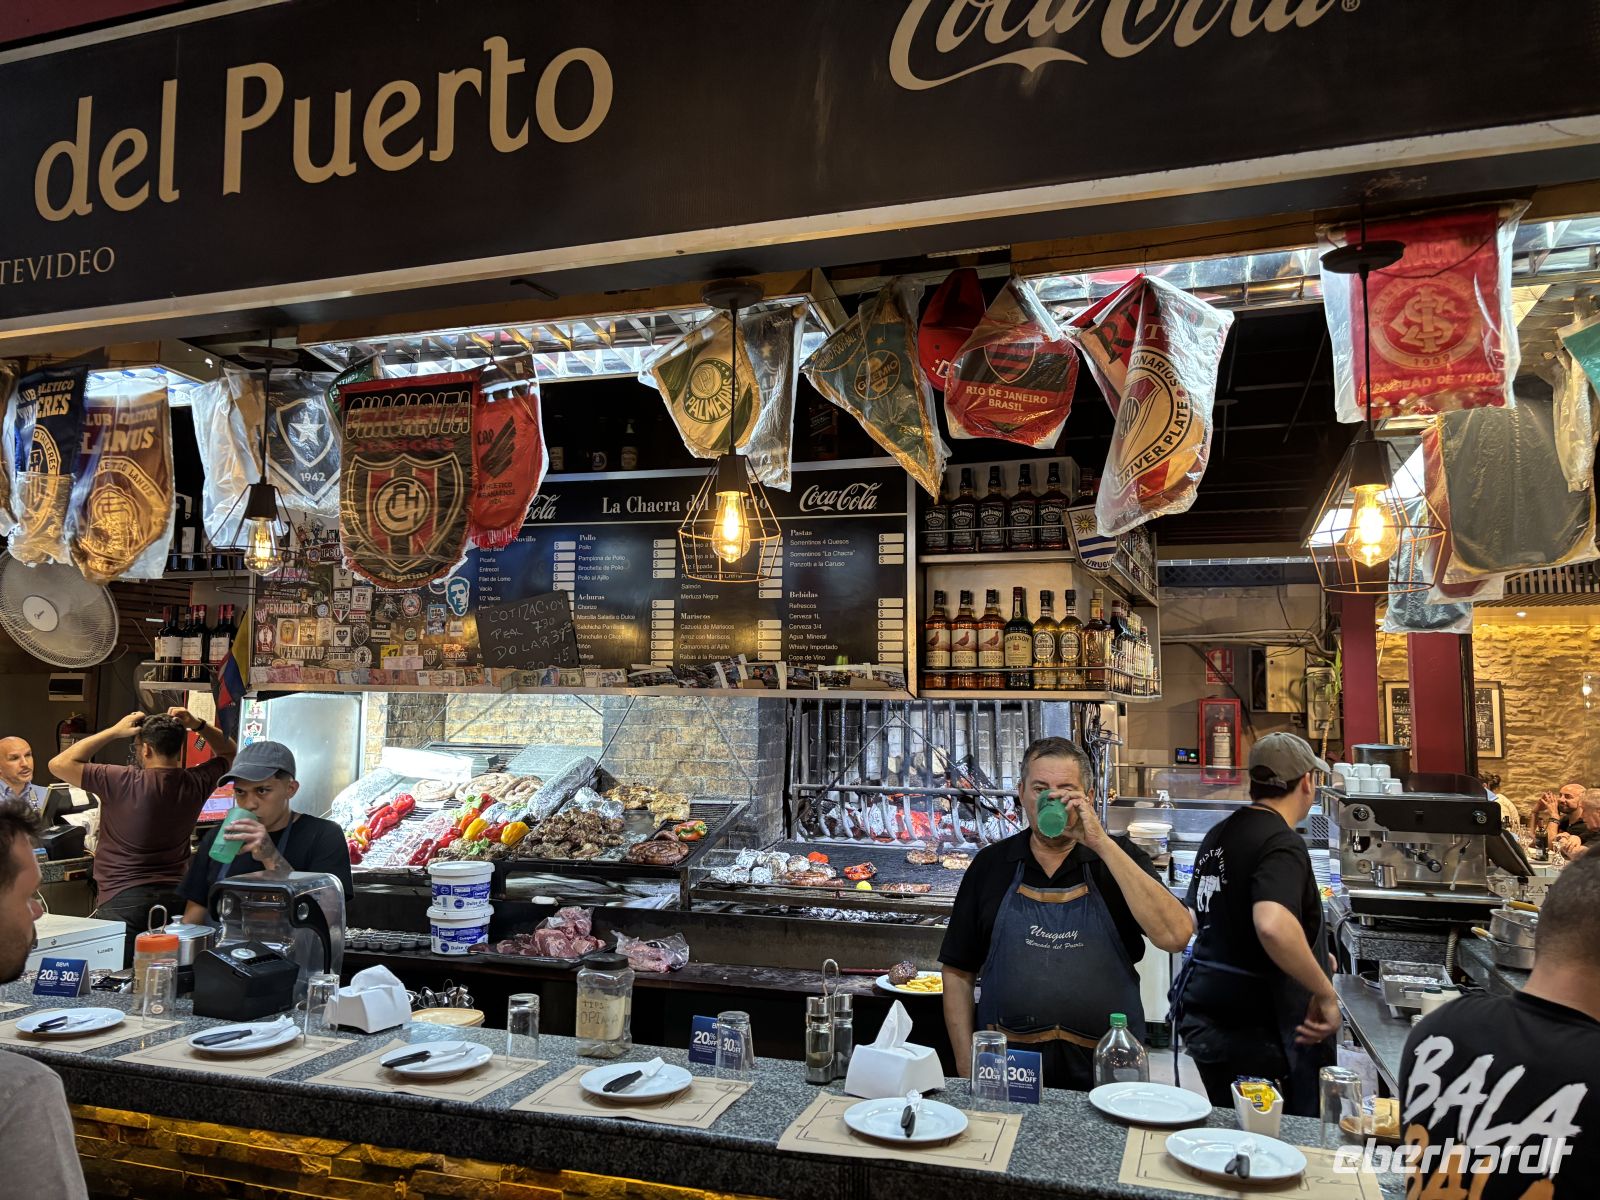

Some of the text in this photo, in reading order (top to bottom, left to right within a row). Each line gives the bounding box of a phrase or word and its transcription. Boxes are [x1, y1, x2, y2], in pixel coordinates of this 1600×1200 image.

[34, 36, 614, 222] del Puerto
[857, 360, 898, 391] GEMIO
[1436, 375, 1454, 384] DE
[685, 377, 738, 421] PALMEIRAS
[966, 386, 1048, 404] RIO DE JANEIRO
[988, 398, 1024, 412] BRASIL
[1125, 445, 1166, 482] RIVER
[1163, 401, 1188, 446] PLATE
[300, 472, 326, 482] 1942
[602, 494, 768, 514] La Chacra del Prto
[800, 482, 882, 512] Coca-Cola
[1085, 556, 1114, 568] URUGU
[1005, 635, 1030, 643] JAMESON
[1025, 938, 1050, 948] Mercado
[1030, 926, 1078, 942] Uruguay
[1403, 1035, 1588, 1179] BALA
